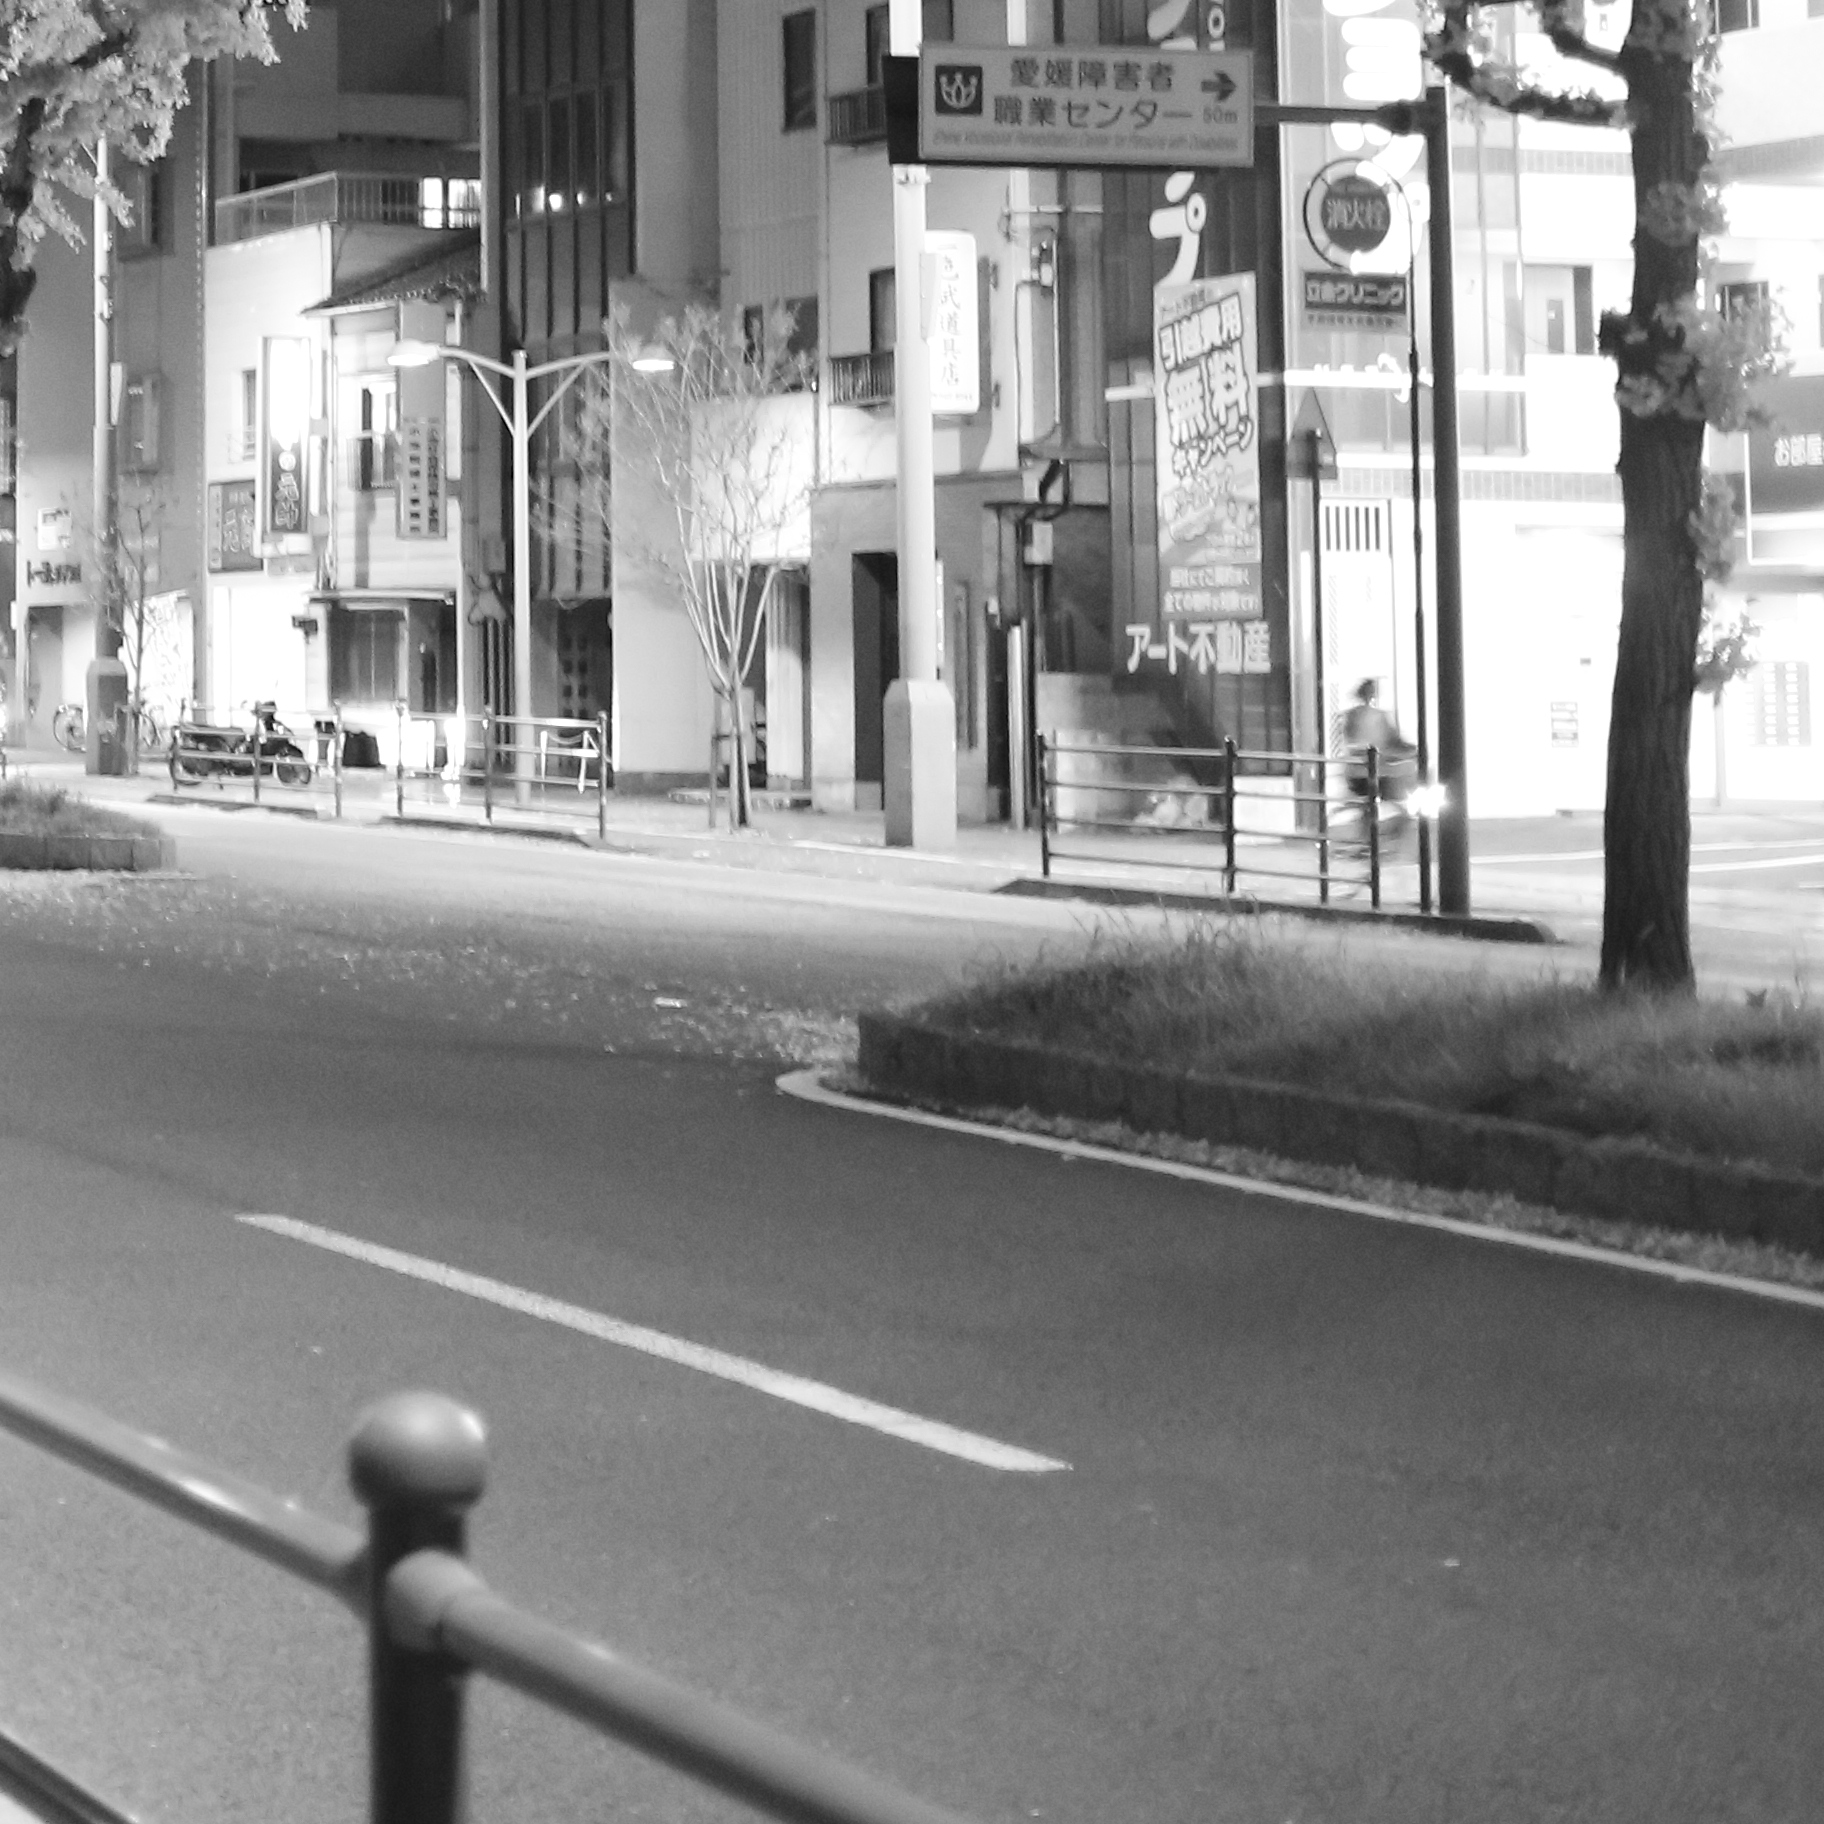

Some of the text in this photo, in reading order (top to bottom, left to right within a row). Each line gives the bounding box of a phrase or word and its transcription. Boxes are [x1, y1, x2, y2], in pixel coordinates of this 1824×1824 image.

[994, 94, 1193, 129] 職業センター
[1326, 198, 1387, 231] 消火栓
[1165, 341, 1249, 447] 無料
[1173, 418, 1252, 476] キャンペーン
[1773, 433, 1824, 467] お部屋
[1126, 620, 1272, 675] アート不動産
